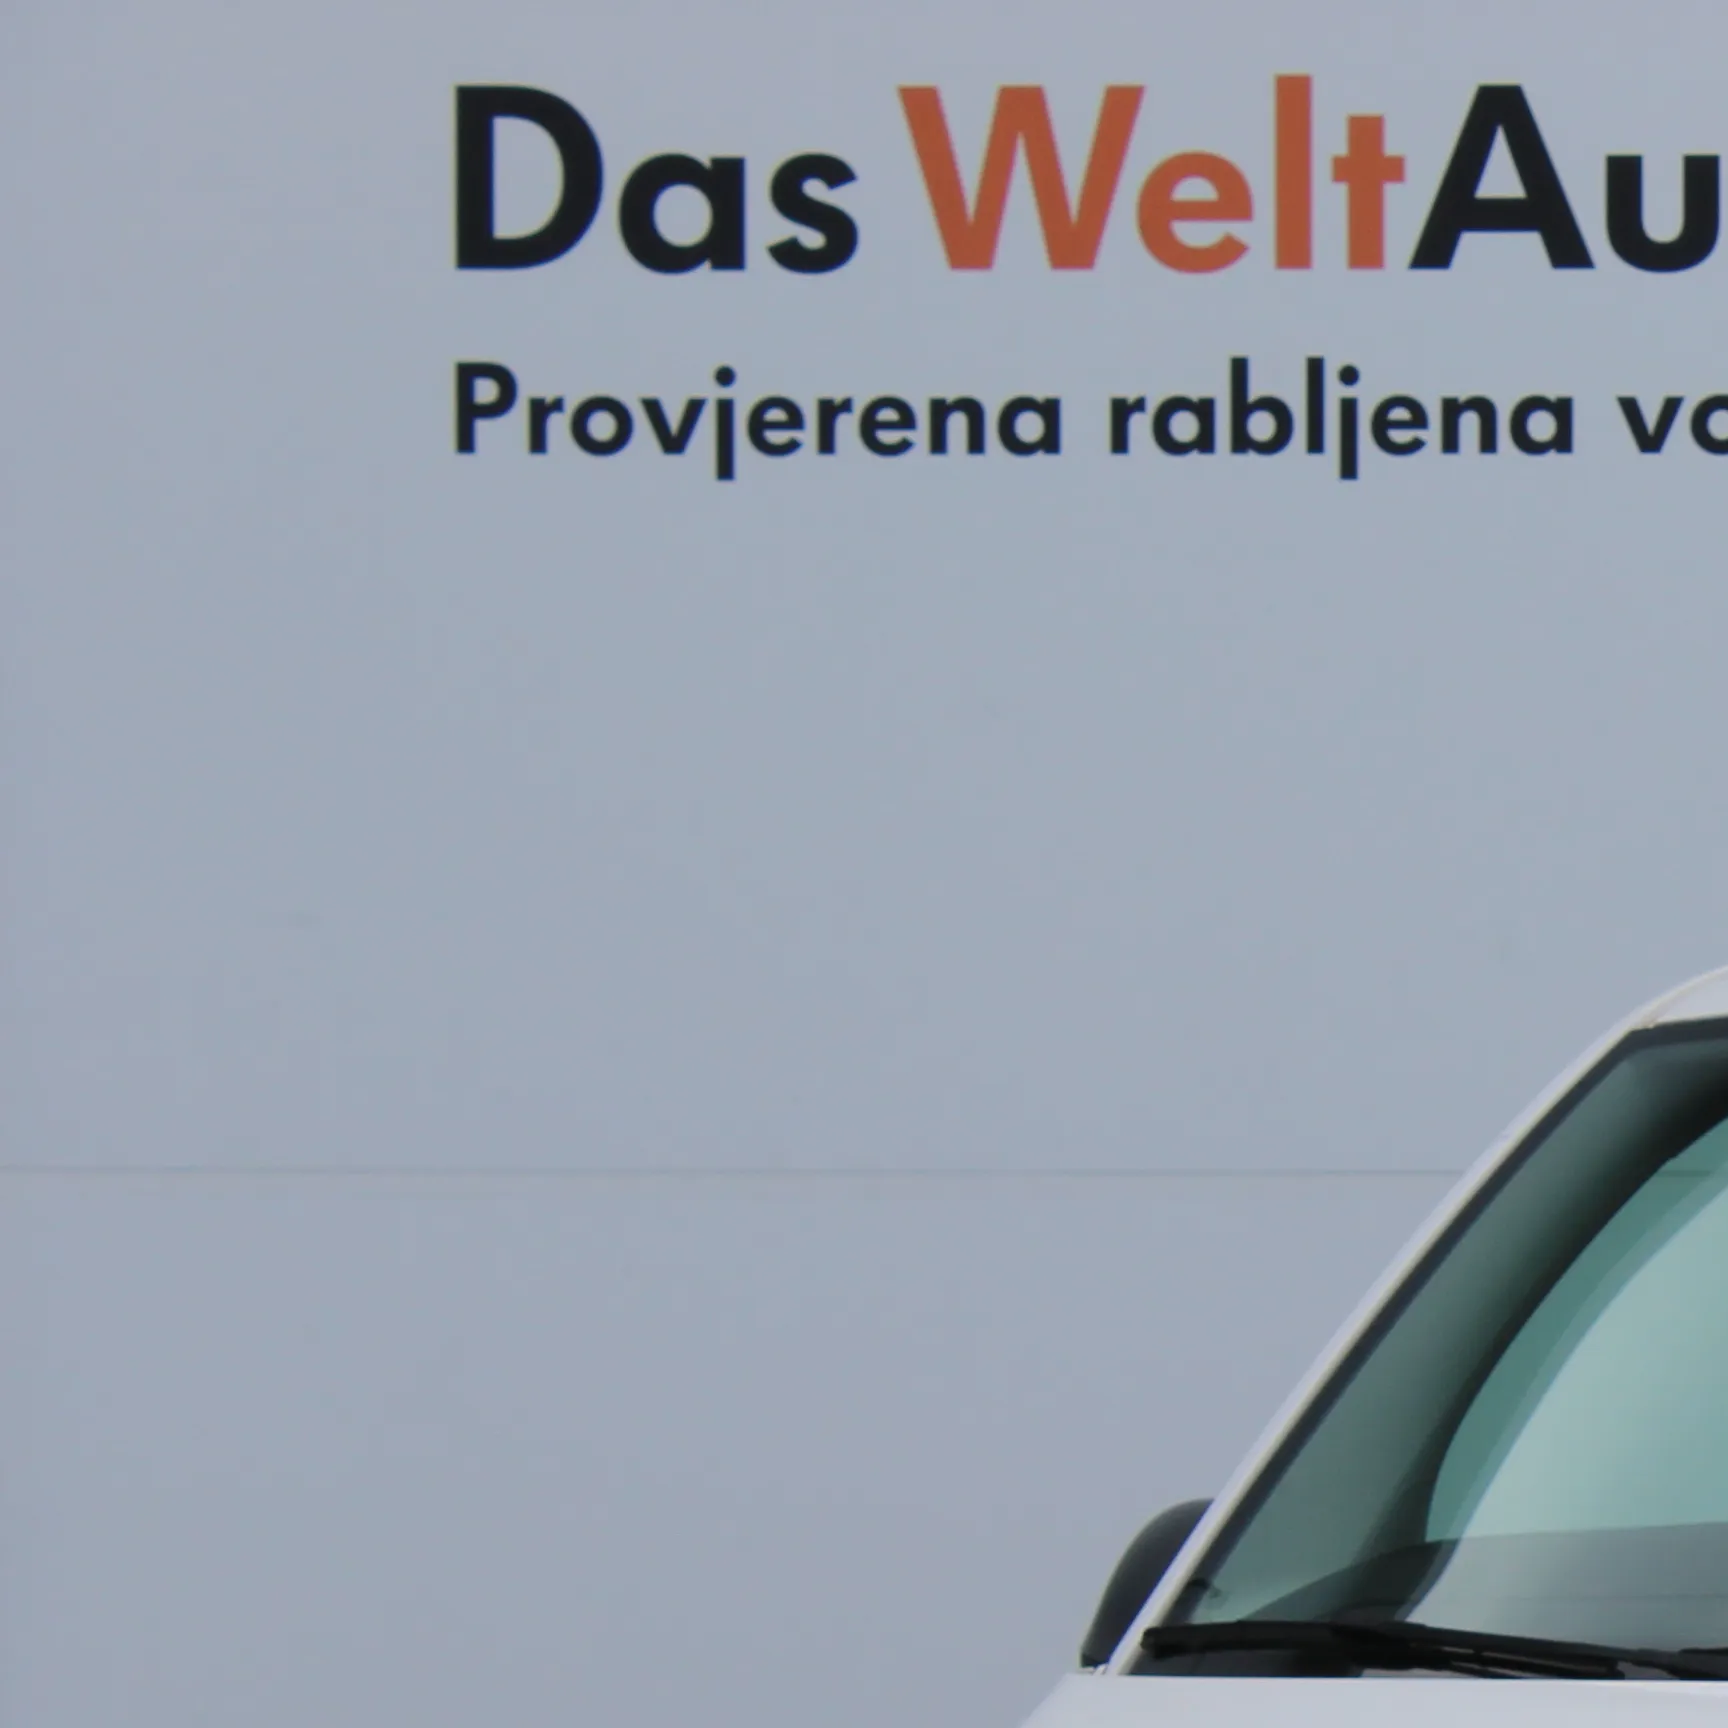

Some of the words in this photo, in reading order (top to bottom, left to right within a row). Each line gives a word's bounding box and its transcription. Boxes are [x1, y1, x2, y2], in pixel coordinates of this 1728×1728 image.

[455, 85, 857, 273] Das
[455, 361, 1060, 481] Provjerena
[1109, 356, 1573, 480] rabljena
